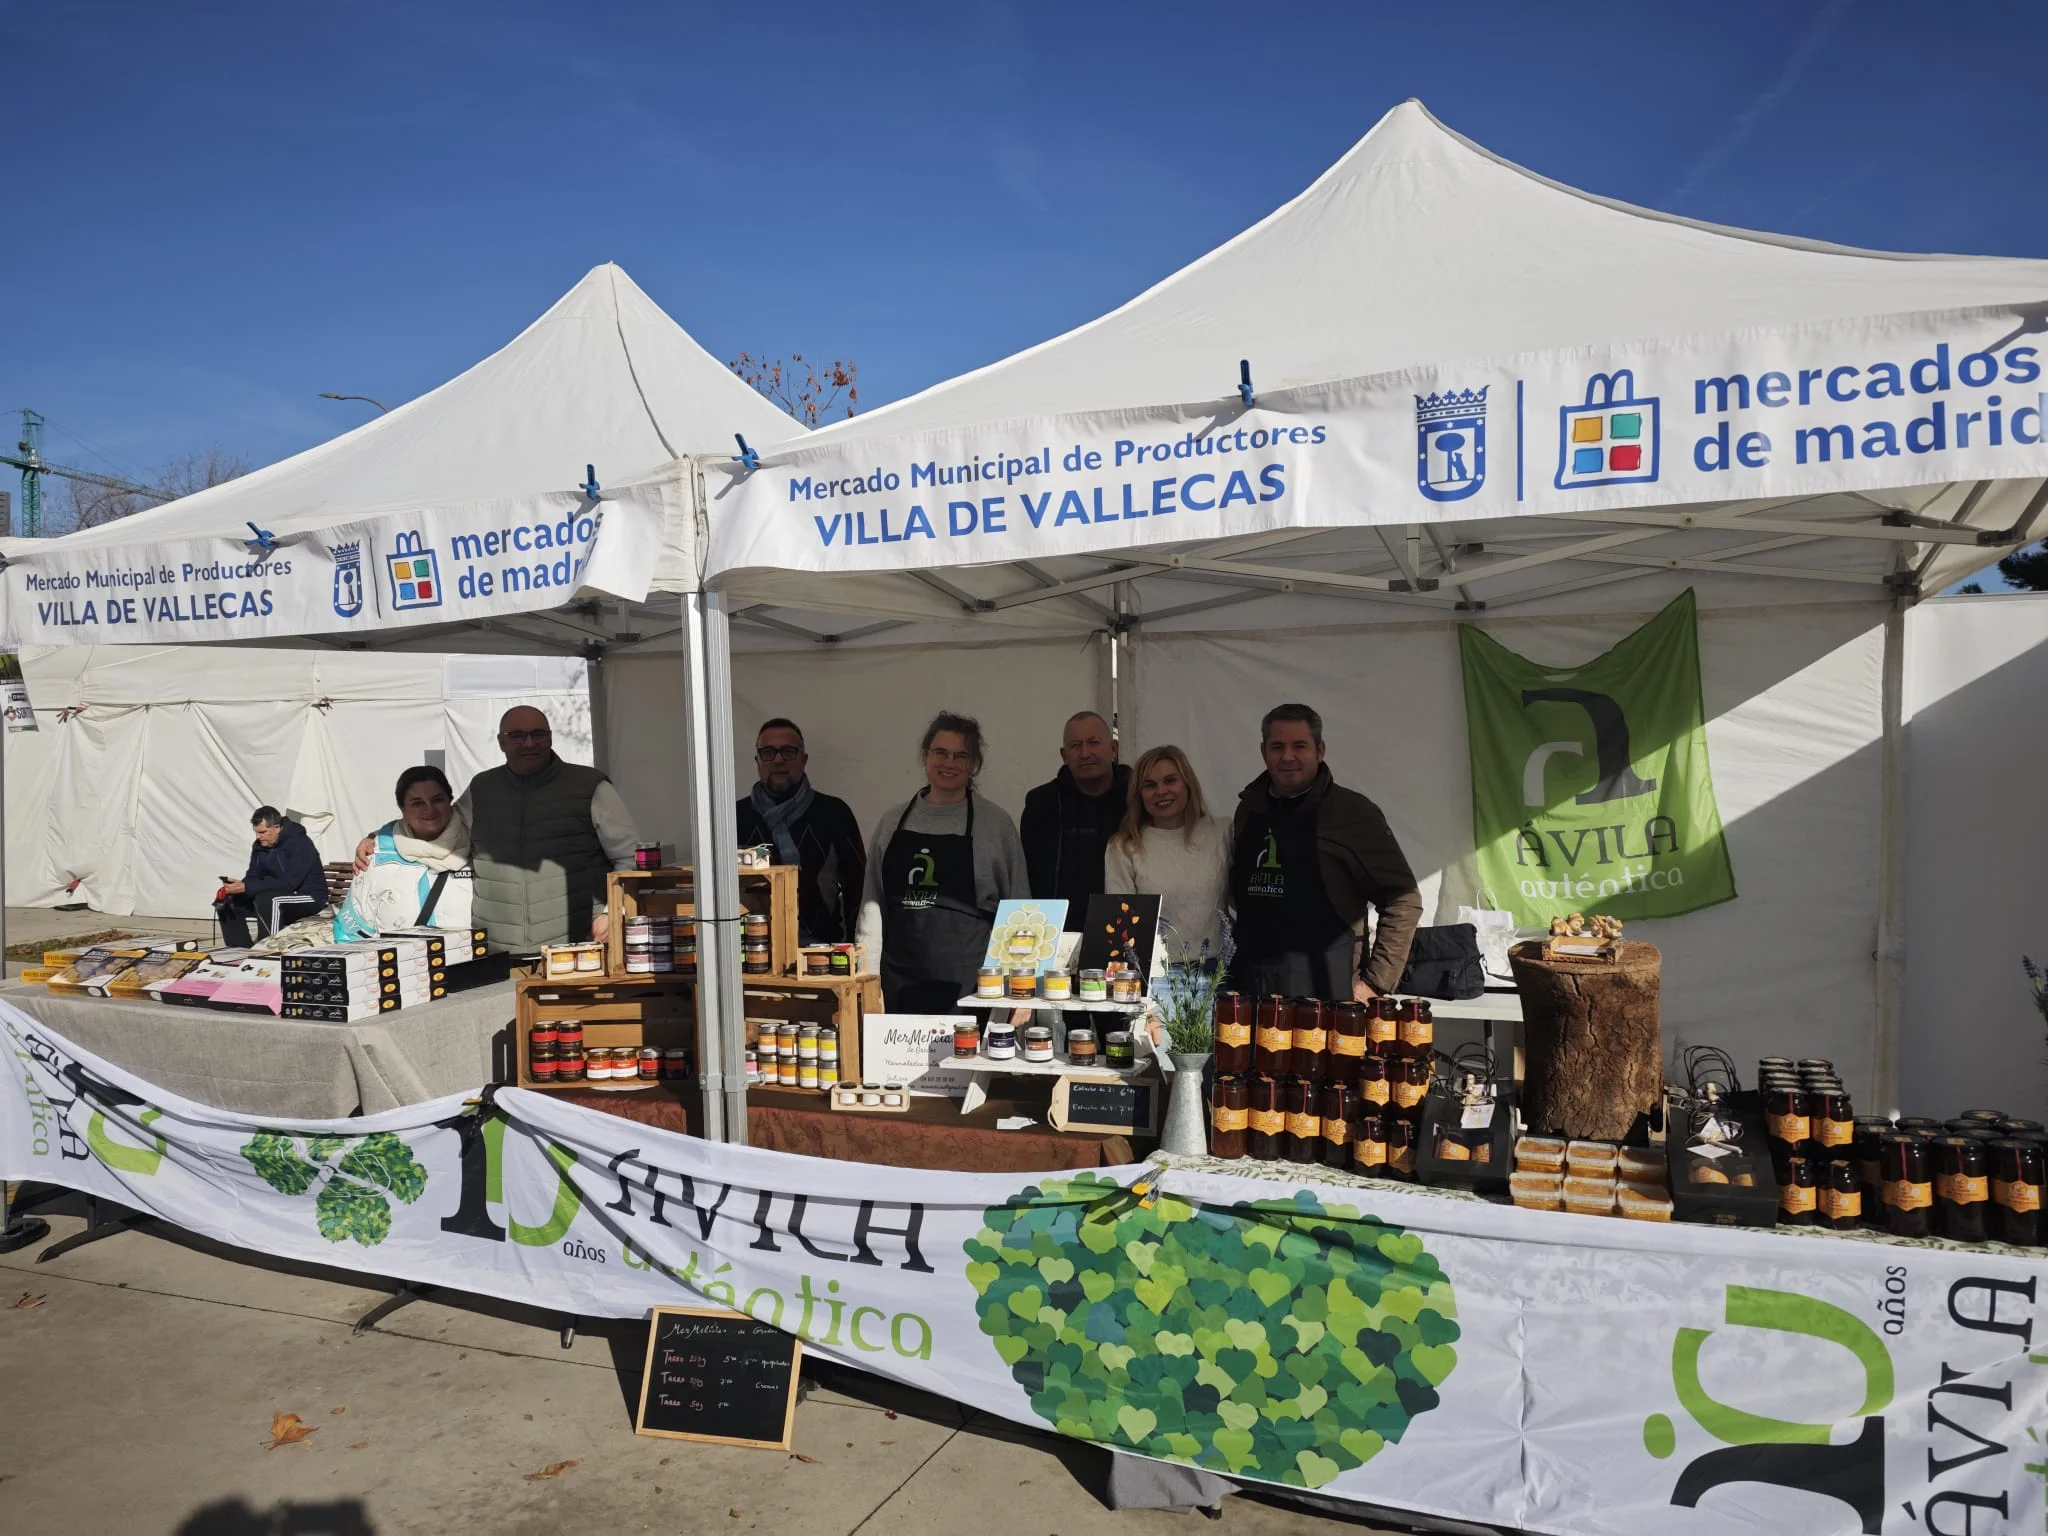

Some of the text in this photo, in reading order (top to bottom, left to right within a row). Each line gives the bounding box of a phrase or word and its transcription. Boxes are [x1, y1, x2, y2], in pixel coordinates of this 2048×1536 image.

[1695, 343, 2041, 414] mercados
[1693, 392, 2048, 472] de madrid
[788, 424, 1327, 502] Mercado Municipal de Productores
[814, 463, 1286, 547] VILLA DE VALLECAS
[26, 560, 292, 592] Mercado Municipal de Productores
[458, 565, 494, 600] de
[38, 589, 274, 626] VILLA DE VALLECAS
[1516, 815, 1679, 868] ÁVILA
[1520, 863, 1684, 900] auténtica
[562, 1236, 607, 1265] años
[1876, 1266, 1908, 1337] años
